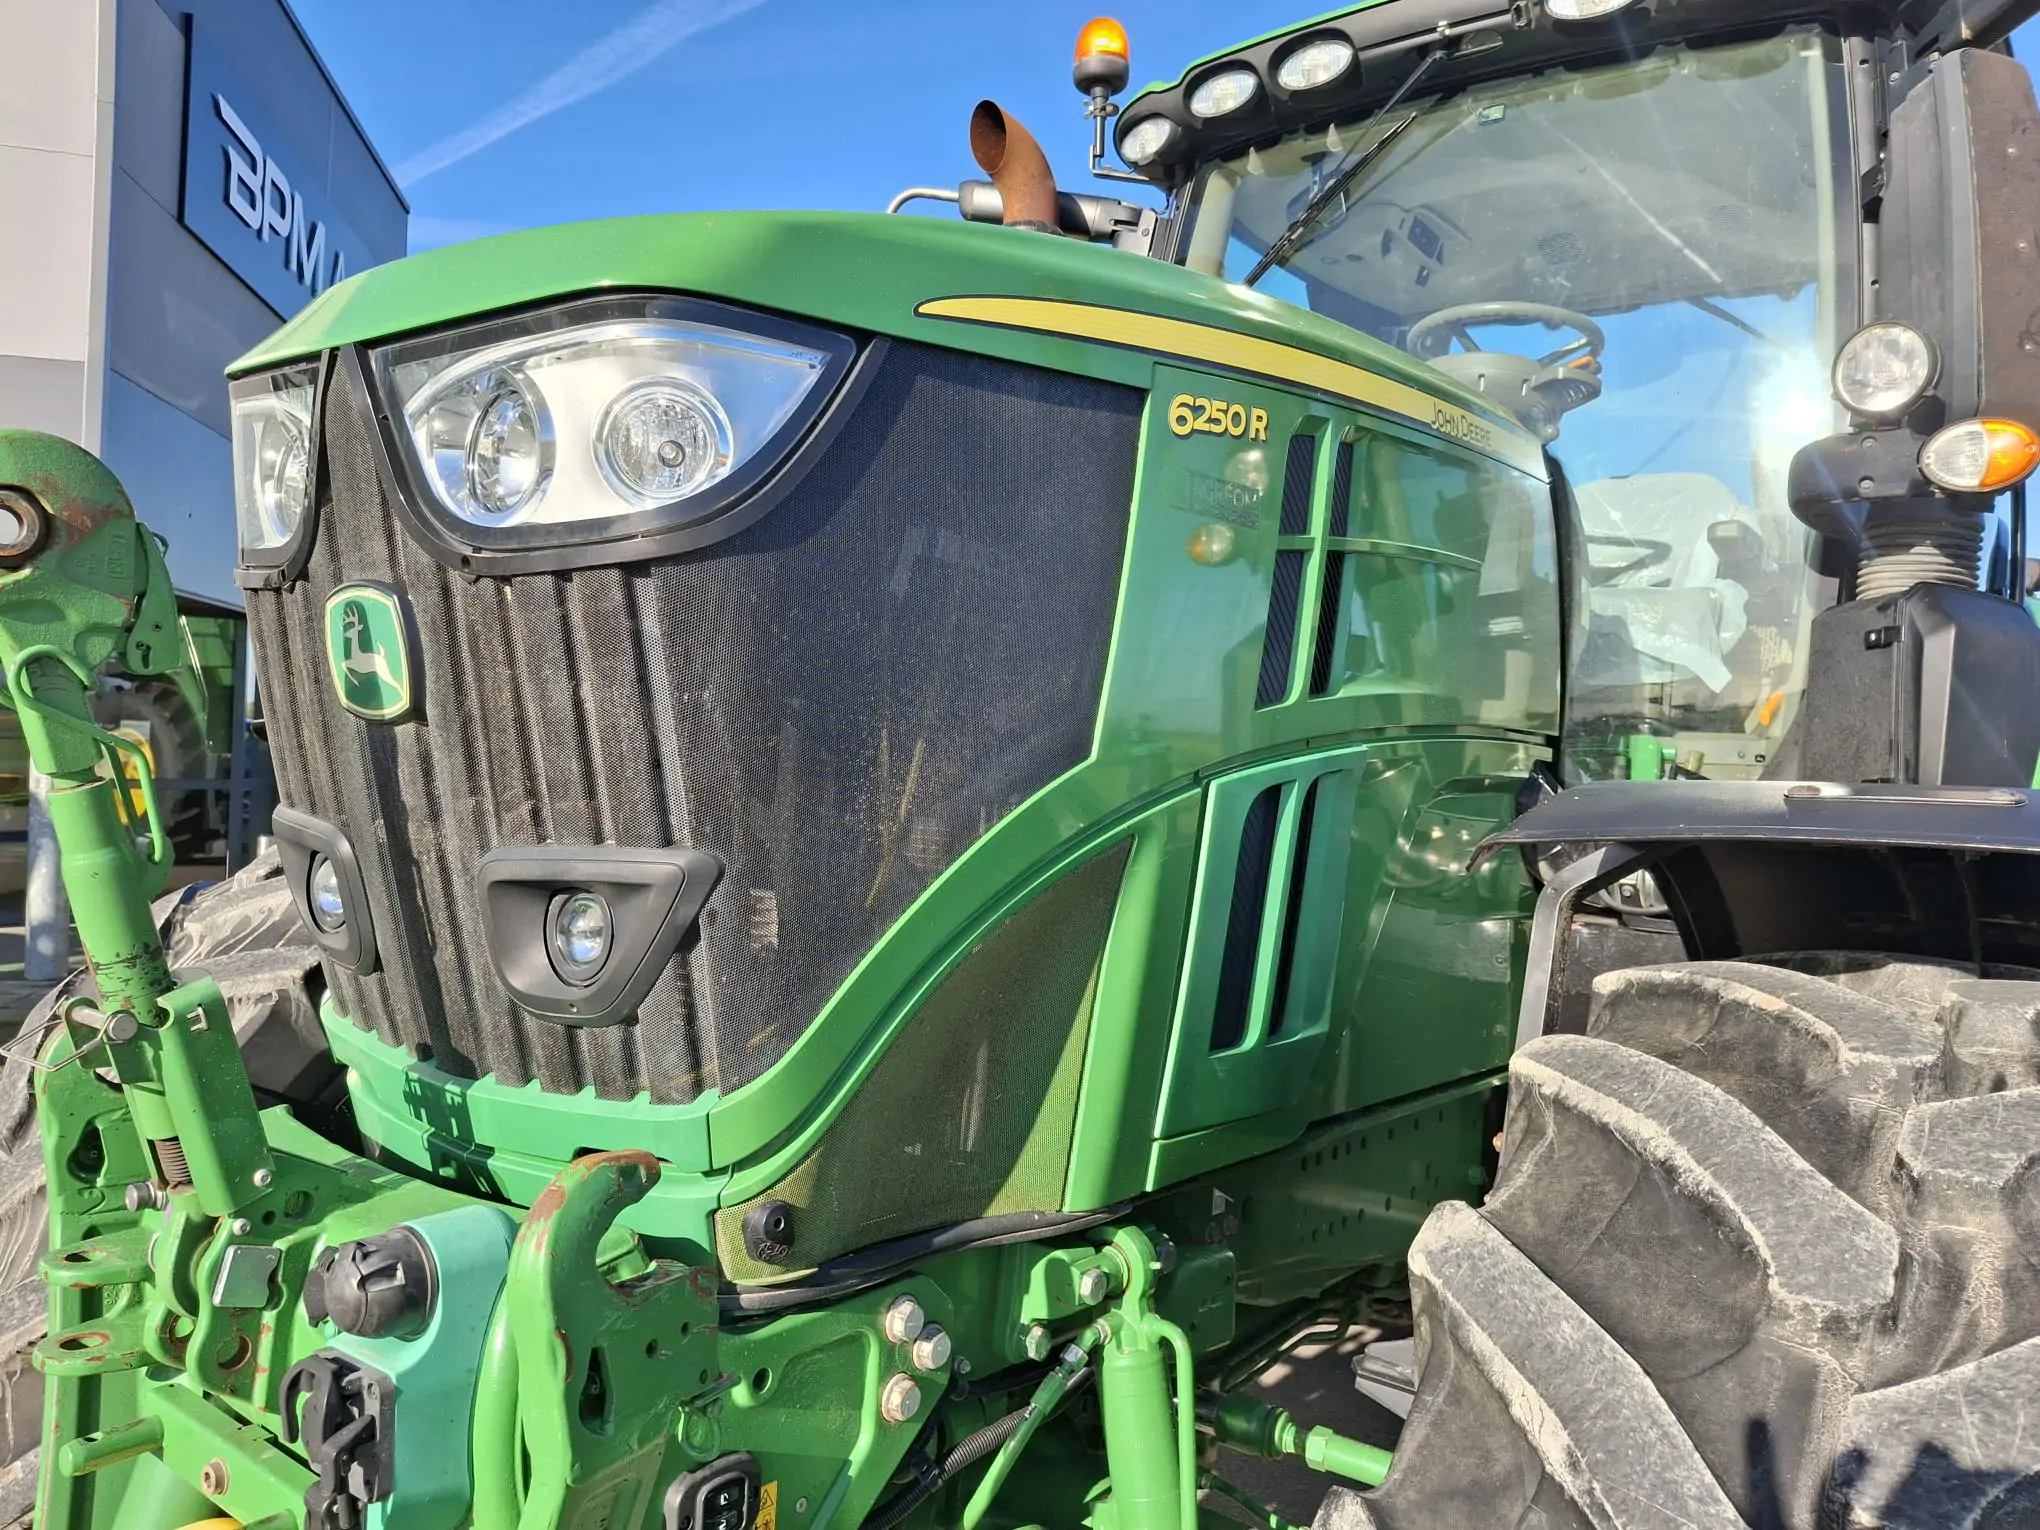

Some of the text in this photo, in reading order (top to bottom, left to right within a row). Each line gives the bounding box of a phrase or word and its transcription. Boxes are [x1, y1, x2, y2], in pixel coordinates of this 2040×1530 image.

[217, 92, 326, 298] BPM
[1431, 402, 1492, 448] JOHN DEERE
